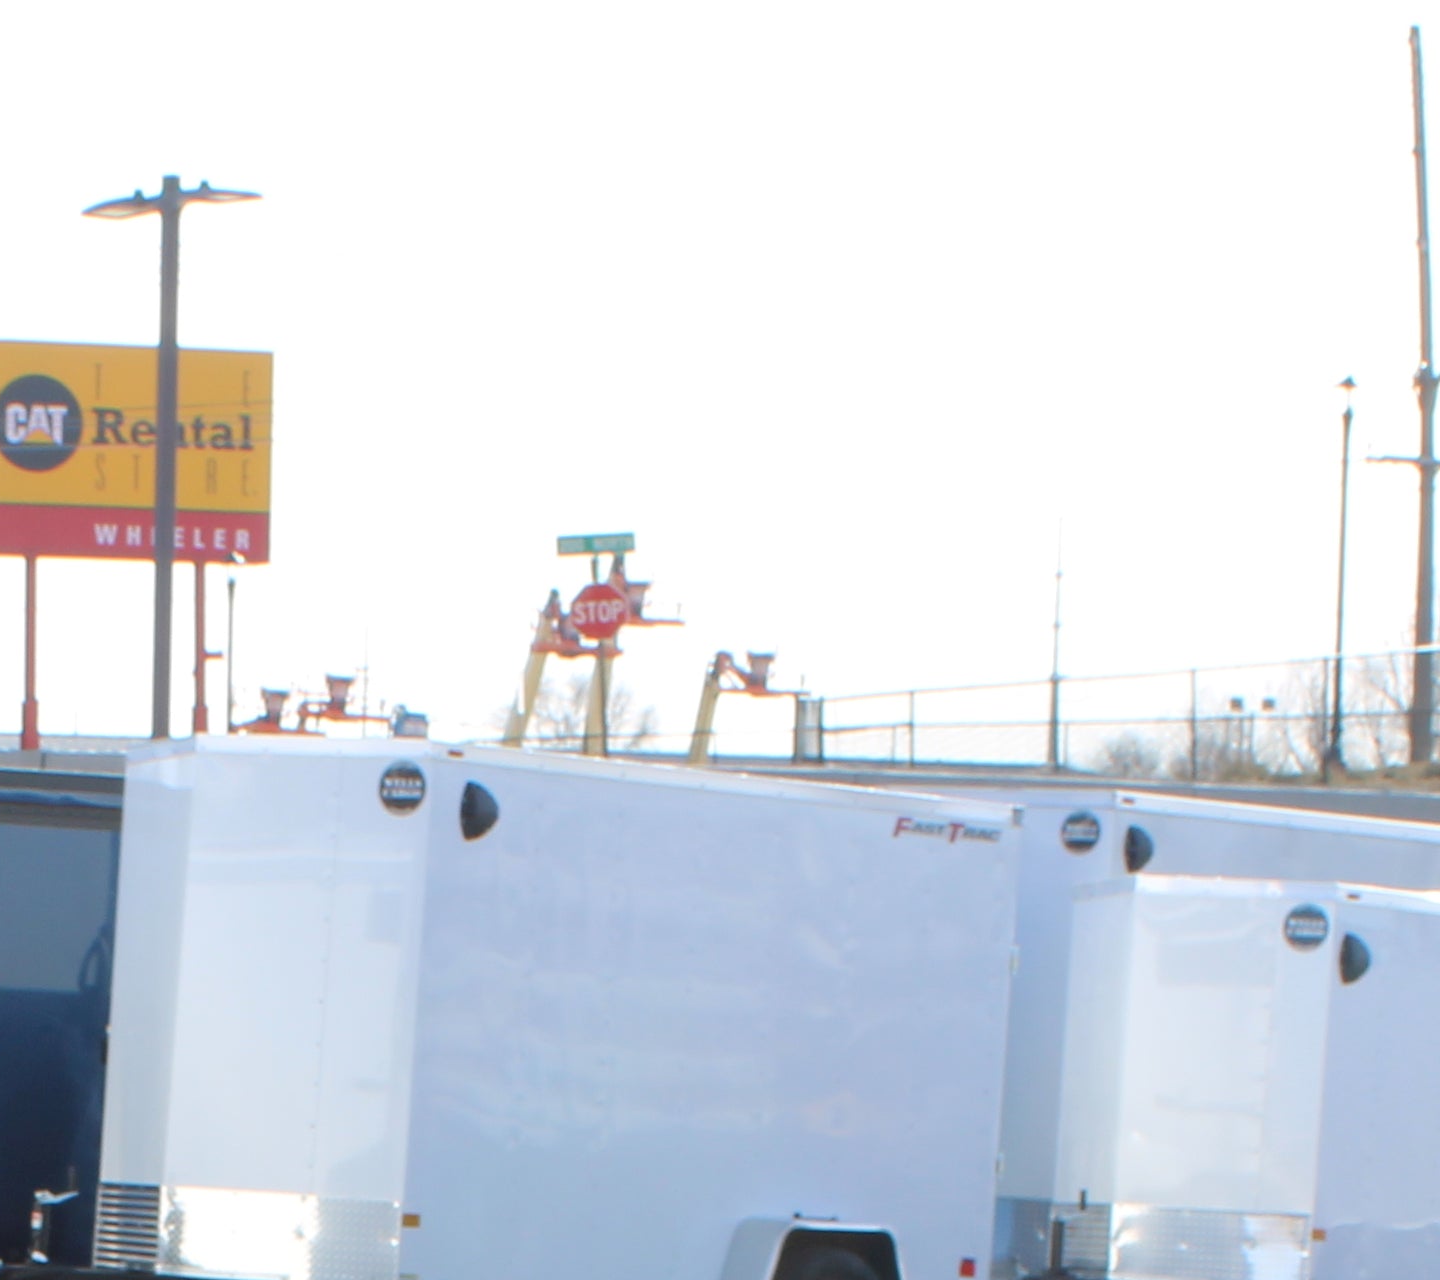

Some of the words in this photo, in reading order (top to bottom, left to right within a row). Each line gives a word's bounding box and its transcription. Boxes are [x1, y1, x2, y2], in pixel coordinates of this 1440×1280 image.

[5, 403, 68, 446] CAT
[94, 453, 253, 497] STRE
[573, 600, 624, 625] STOP
